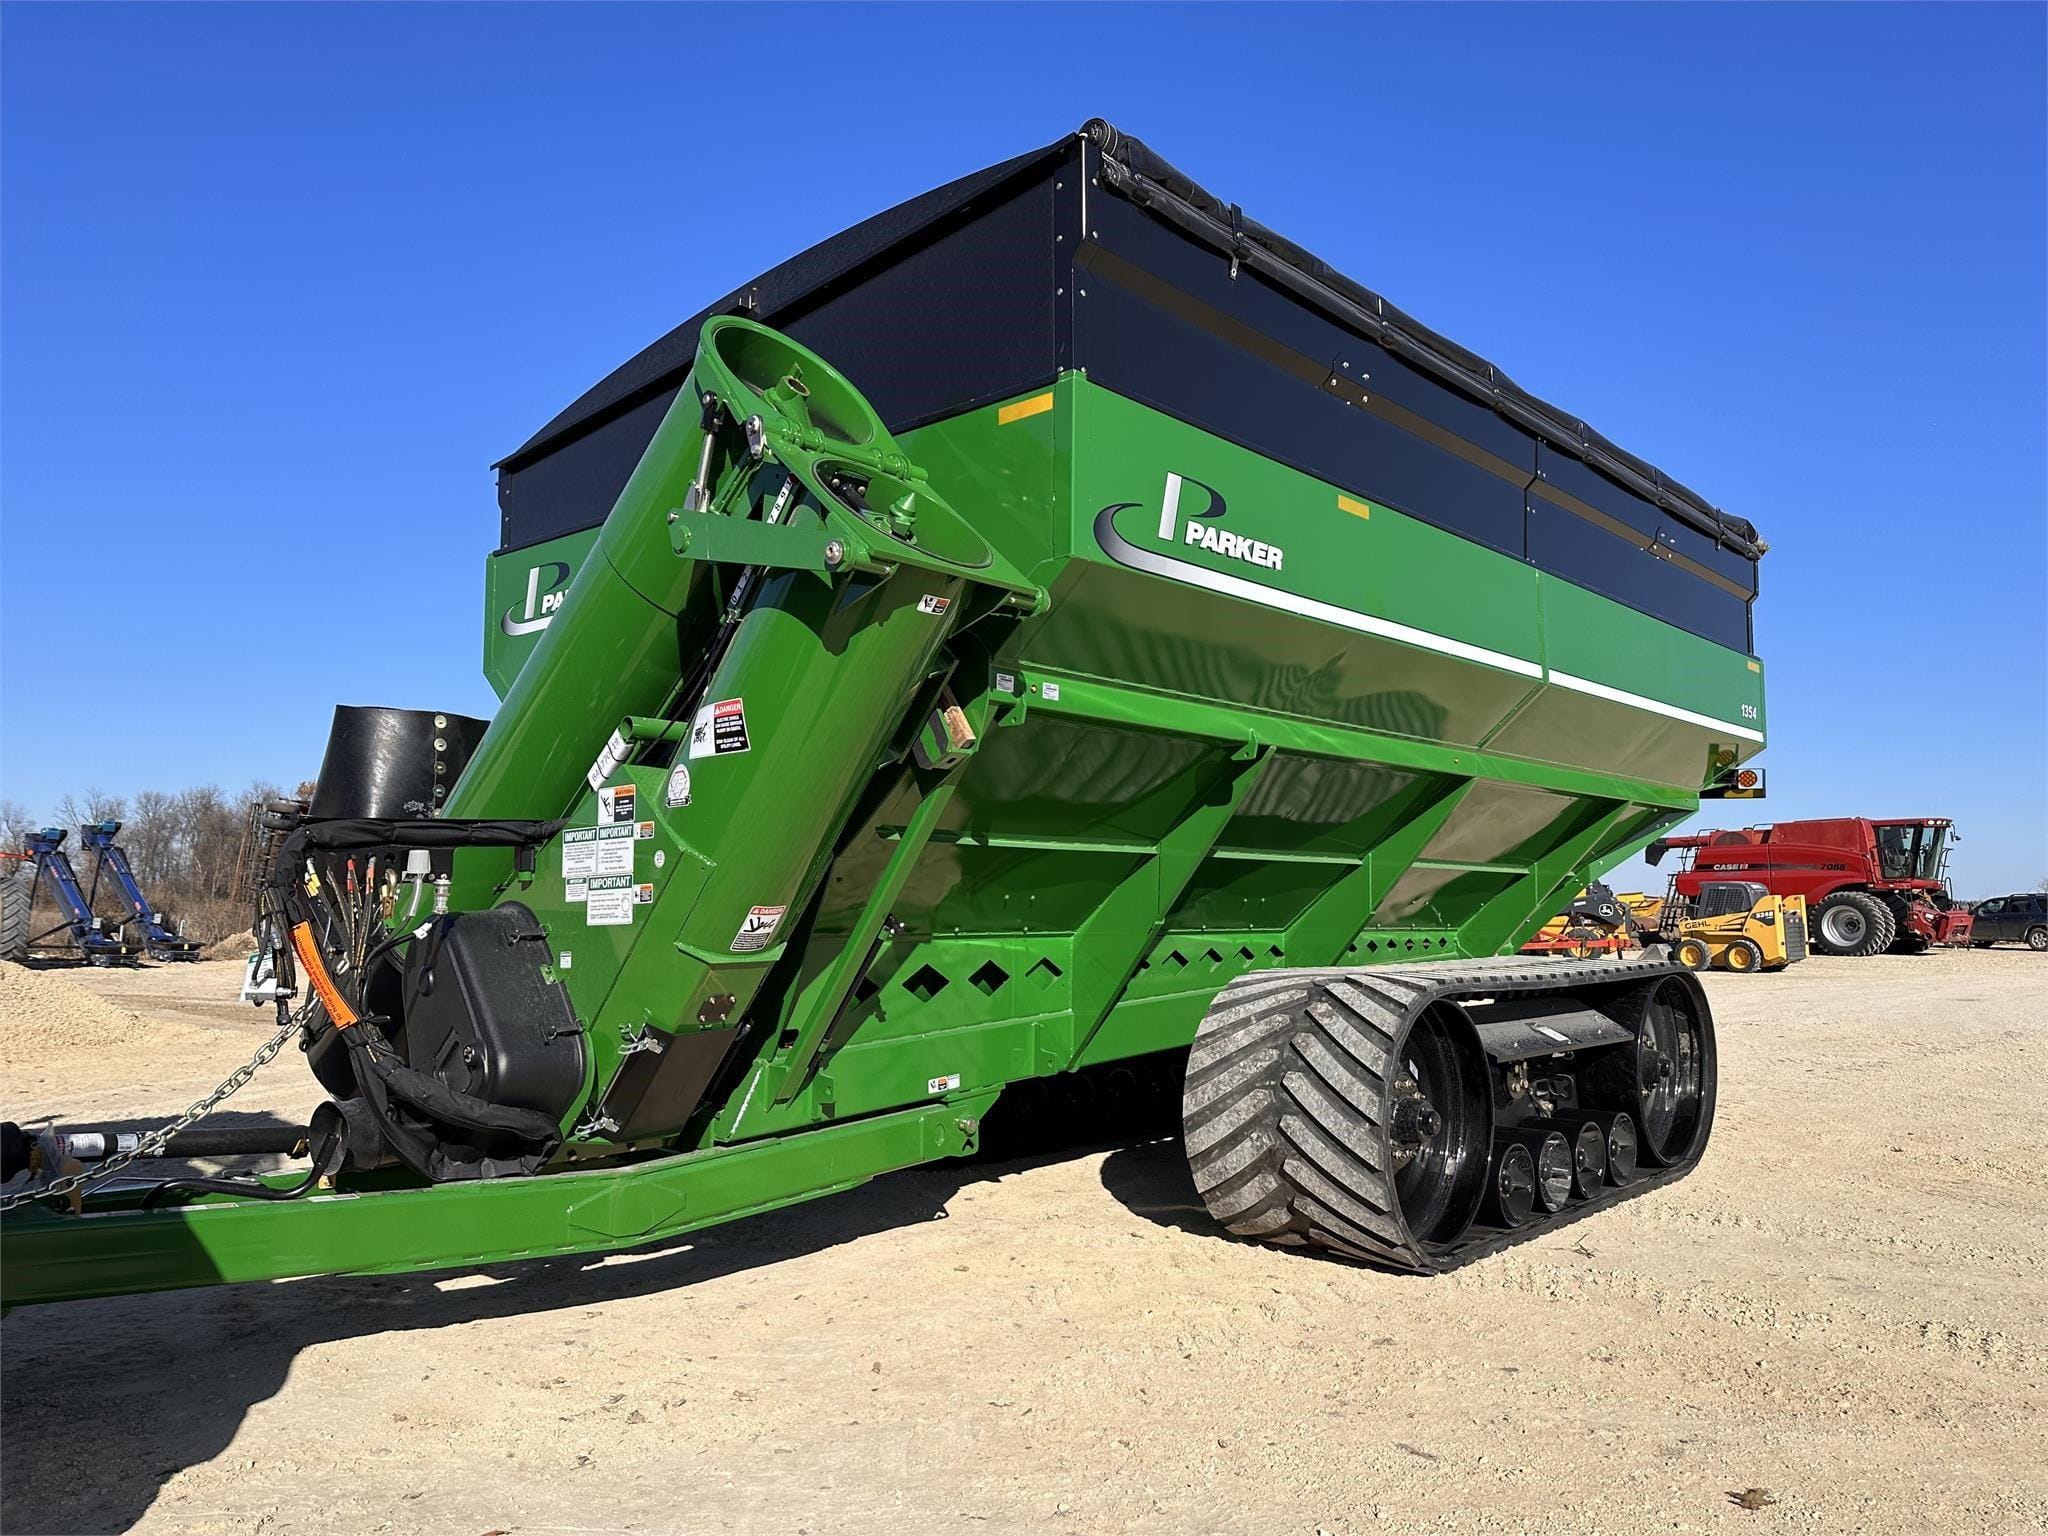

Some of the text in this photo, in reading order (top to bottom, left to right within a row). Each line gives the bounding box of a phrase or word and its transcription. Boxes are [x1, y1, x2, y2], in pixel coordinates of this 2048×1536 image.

[1185, 520, 1284, 571] PARKER
[541, 589, 569, 614] PA
[719, 702, 742, 713] DANGER
[1741, 703, 1757, 720] 1354
[564, 830, 596, 842] IMPORTANT
[600, 826, 632, 839] IMPORTANT
[1713, 863, 1739, 871] CASE
[1820, 863, 1846, 871] 7088
[590, 876, 630, 889] IMPORTANT
[1684, 920, 1711, 930] GEHL
